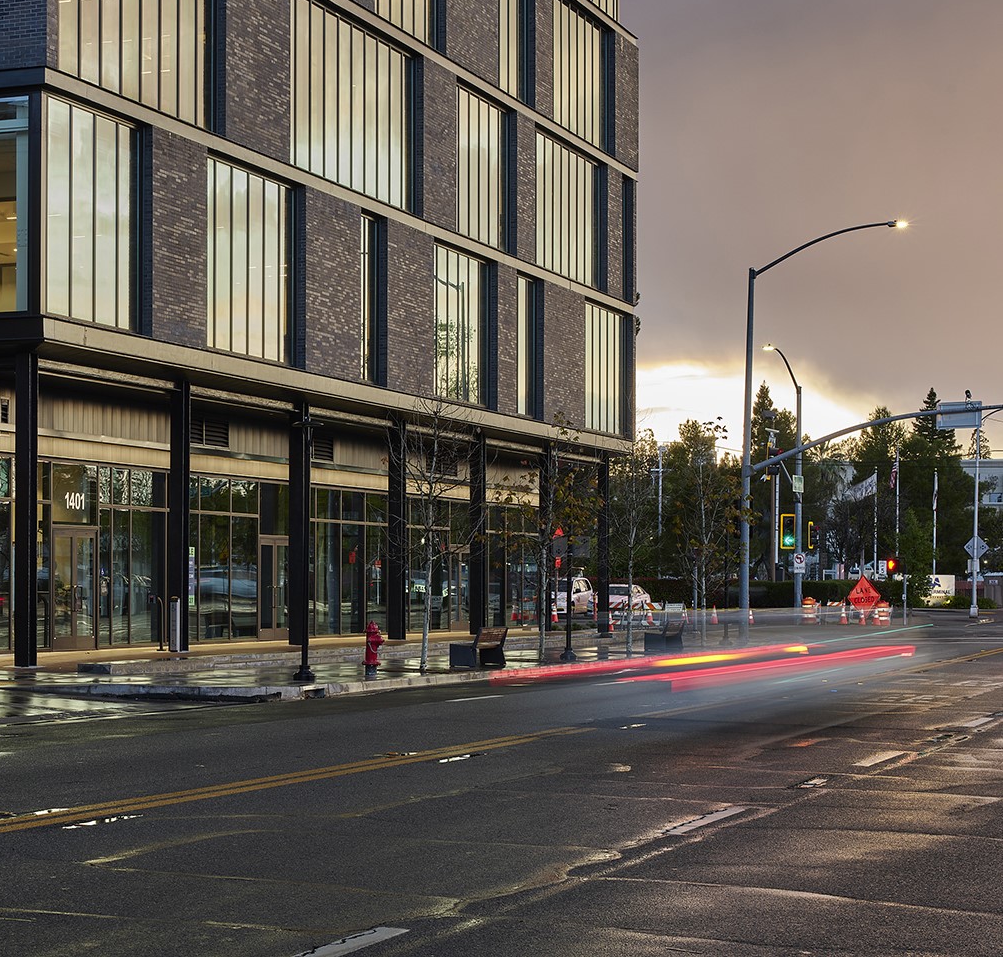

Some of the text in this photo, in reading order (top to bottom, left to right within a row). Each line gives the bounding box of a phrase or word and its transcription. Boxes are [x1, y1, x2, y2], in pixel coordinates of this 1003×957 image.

[64, 492, 85, 510] 1401
[855, 586, 872, 595] LANE
[853, 595, 875, 604] CLOSED
